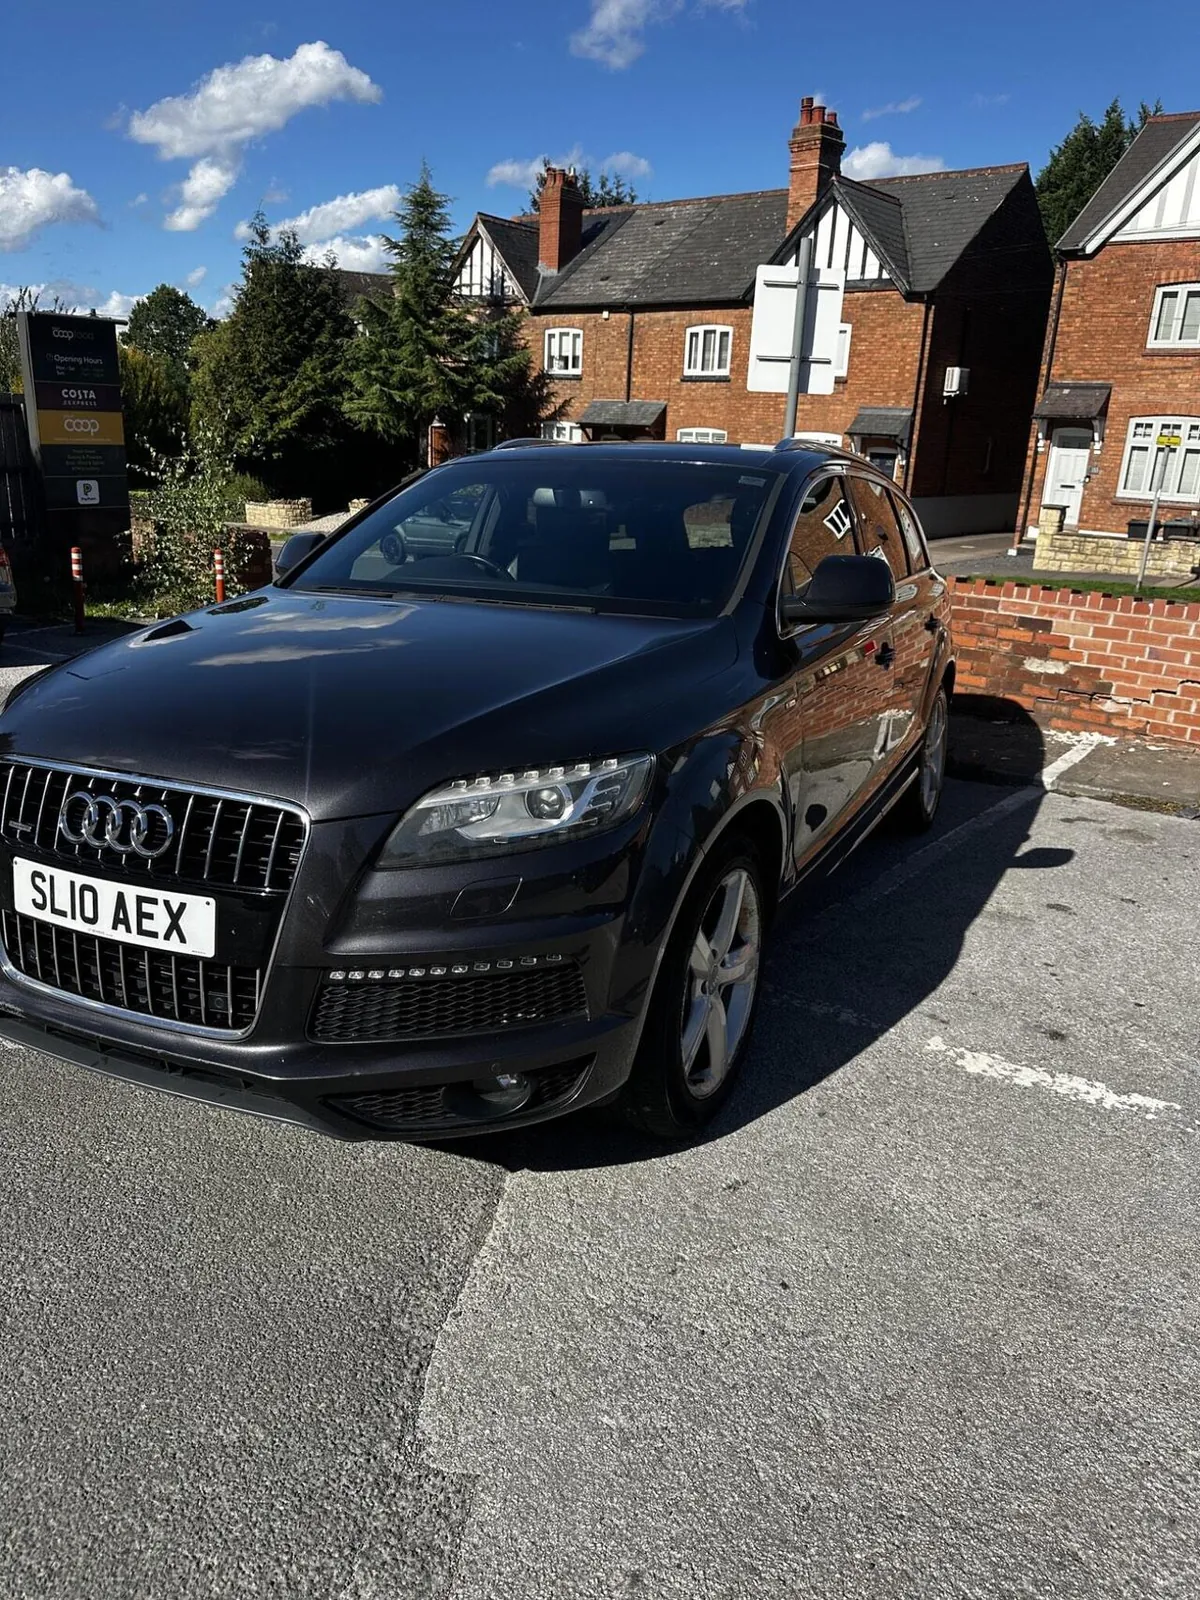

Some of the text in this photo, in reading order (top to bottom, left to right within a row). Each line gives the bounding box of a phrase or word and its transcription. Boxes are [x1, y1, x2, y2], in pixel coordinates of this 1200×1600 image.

[53, 353, 104, 365] Opening Hours
[61, 388, 96, 400] COSTA
[30, 870, 188, 945] SL10 AEX
